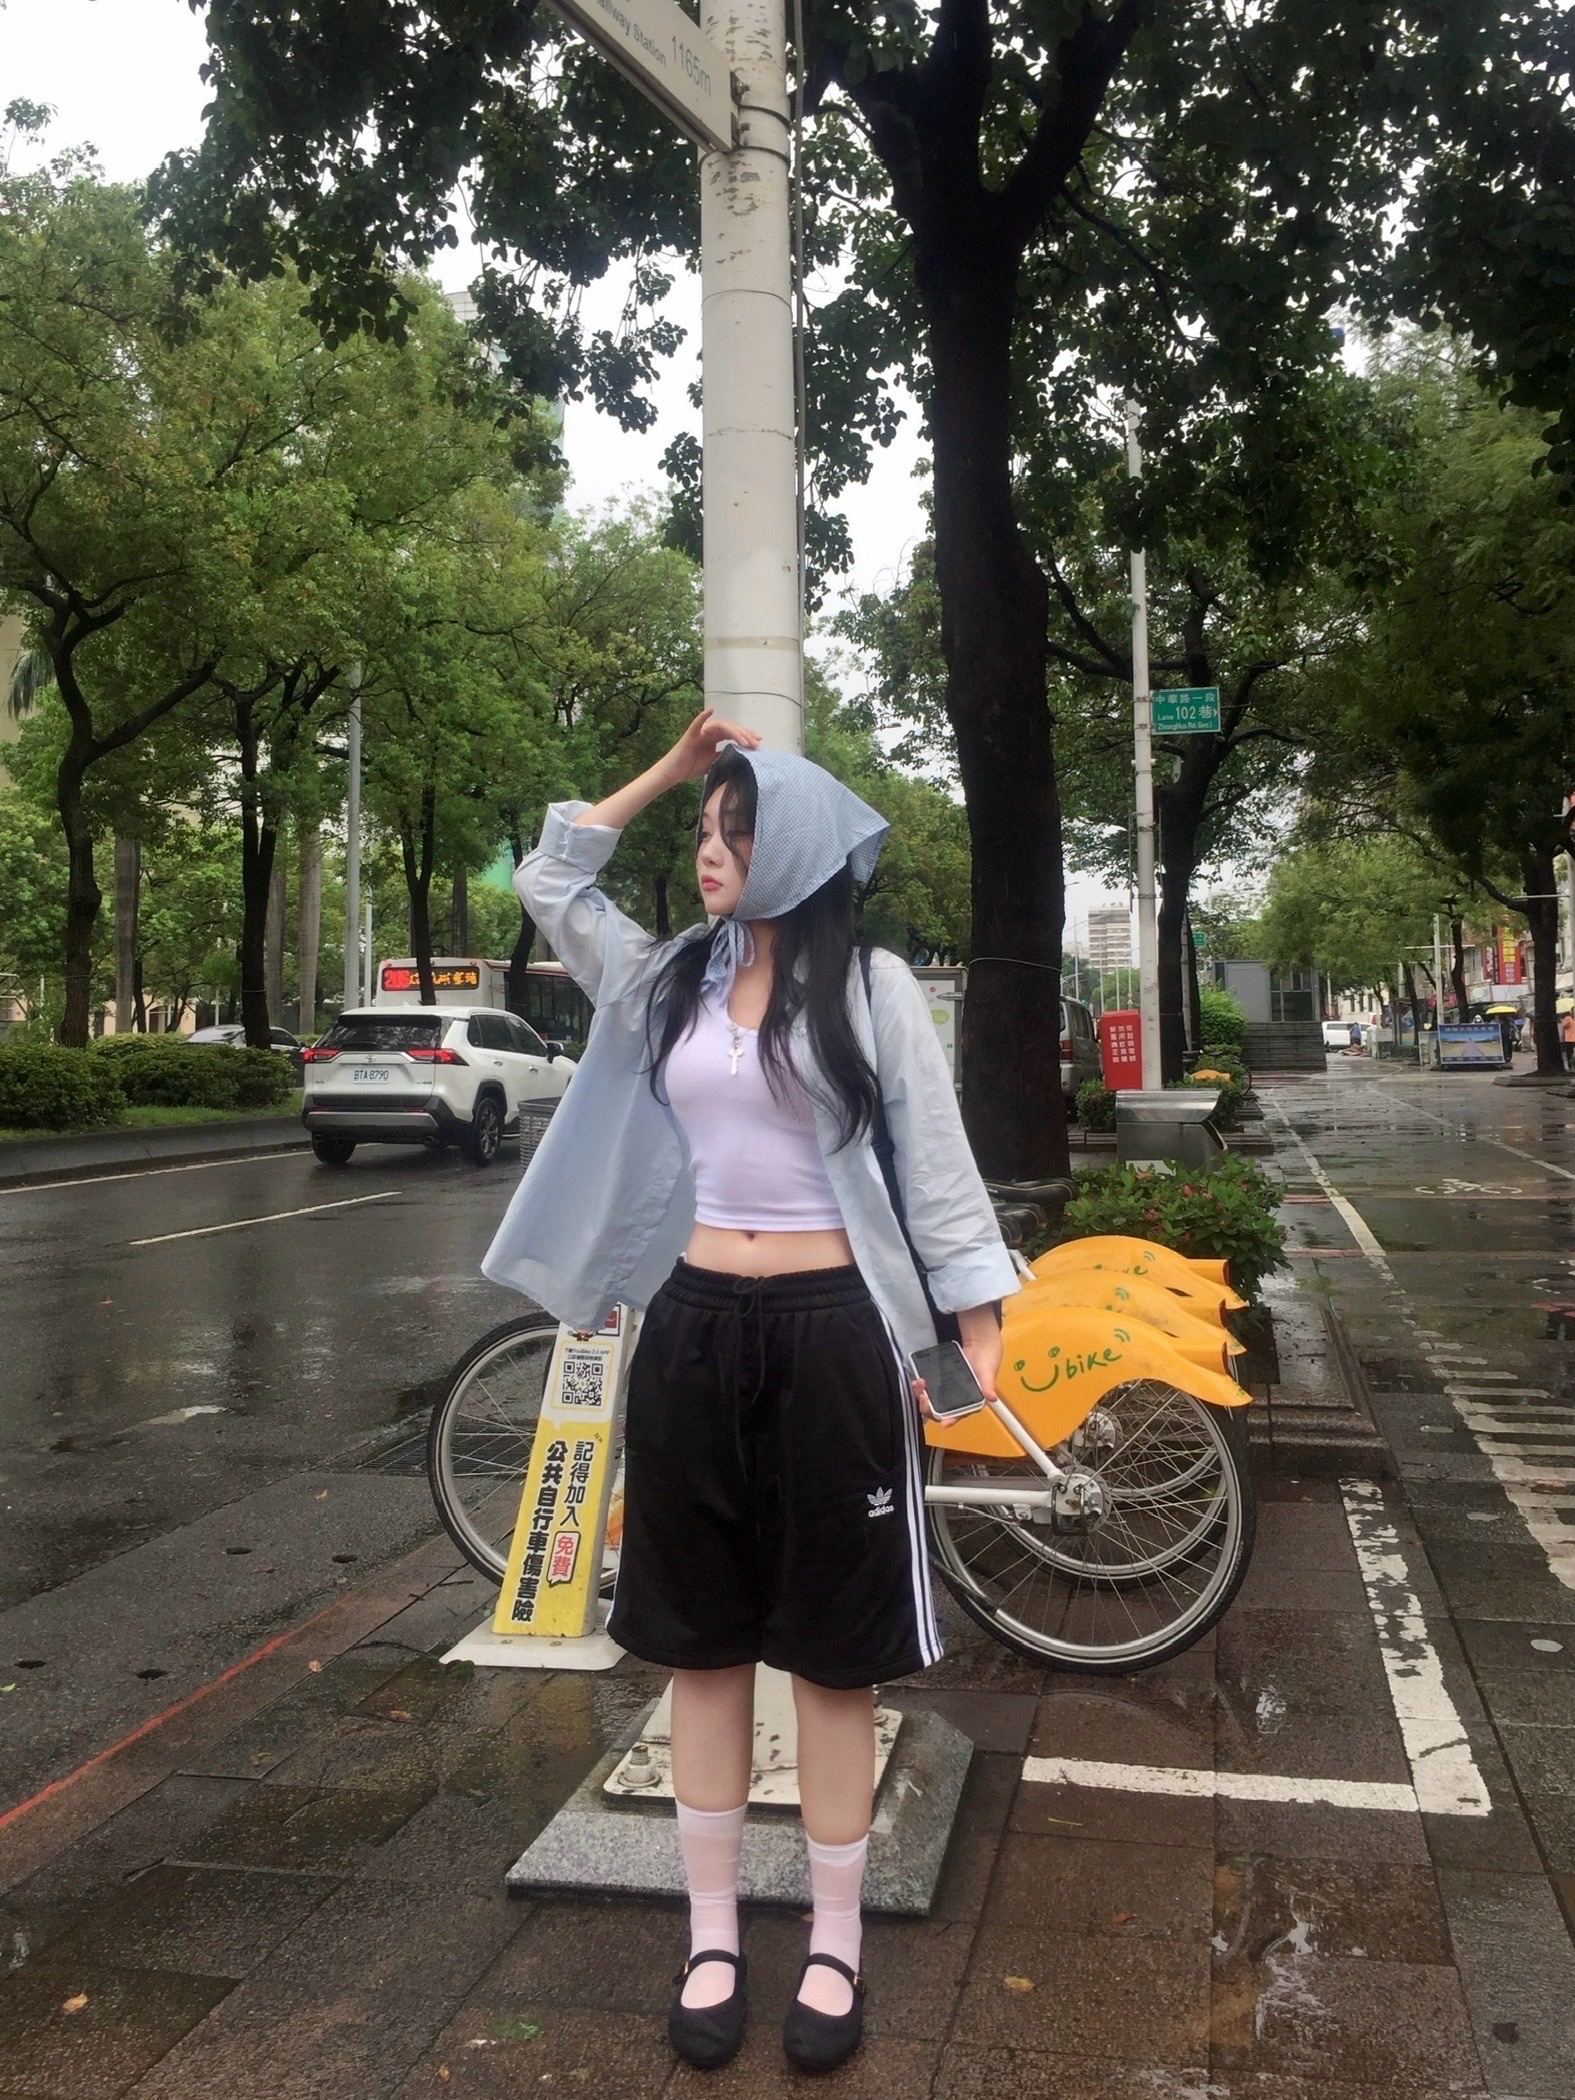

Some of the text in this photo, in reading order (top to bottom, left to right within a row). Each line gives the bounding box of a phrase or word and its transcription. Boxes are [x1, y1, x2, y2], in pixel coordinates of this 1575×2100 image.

[597, 0, 667, 67] ailway Station
[671, 35, 712, 98] 1165m
[1155, 693, 1215, 704] 中華路一段
[1175, 706, 1196, 720] 102
[511, 1440, 569, 1622] 公共自行車傷害險
[551, 1440, 593, 1577] 記得加入 免費
[868, 1505, 895, 1518] adidas
